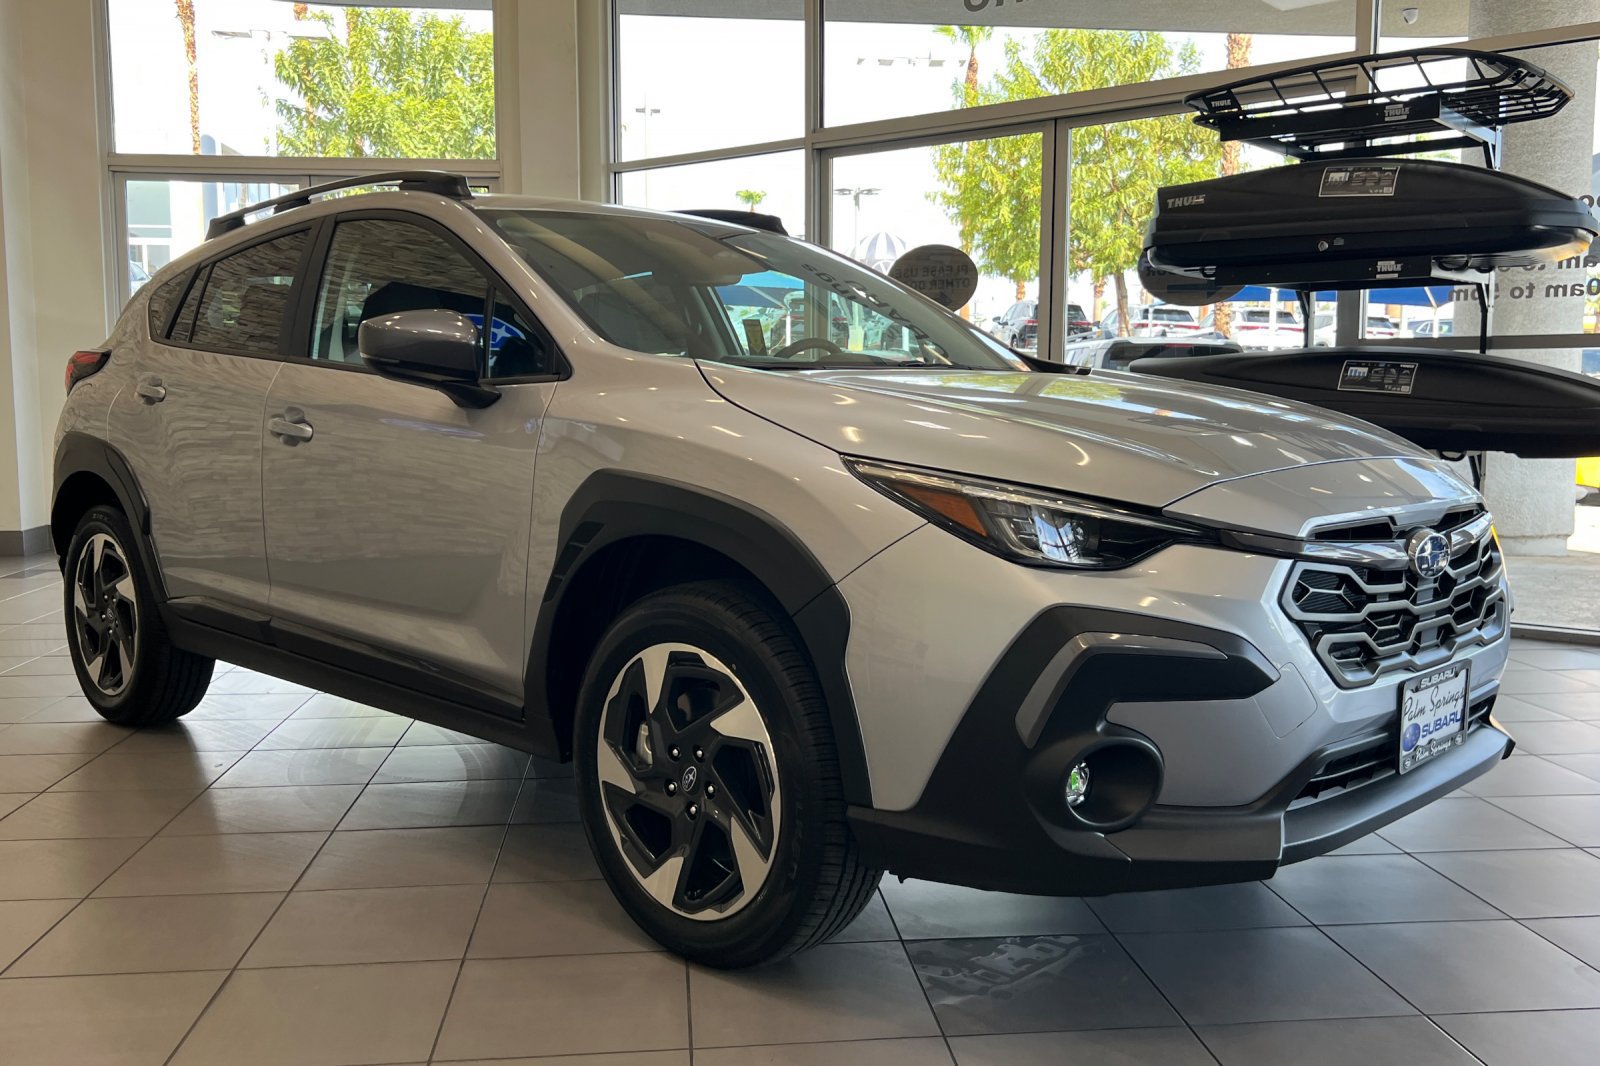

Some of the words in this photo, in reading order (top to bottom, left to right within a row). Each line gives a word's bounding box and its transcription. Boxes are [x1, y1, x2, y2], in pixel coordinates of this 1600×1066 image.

[1211, 99, 1231, 107] THULE
[1384, 107, 1410, 117] THULE
[1167, 194, 1206, 209] THULE
[1376, 263, 1403, 272] THULE
[1420, 670, 1455, 688] SUBARU
[1404, 697, 1426, 722] Palm
[1430, 686, 1464, 717] Springs
[1421, 712, 1461, 737] SUBARU
[1416, 748, 1429, 761] Palm
[1431, 740, 1451, 755] Springs
